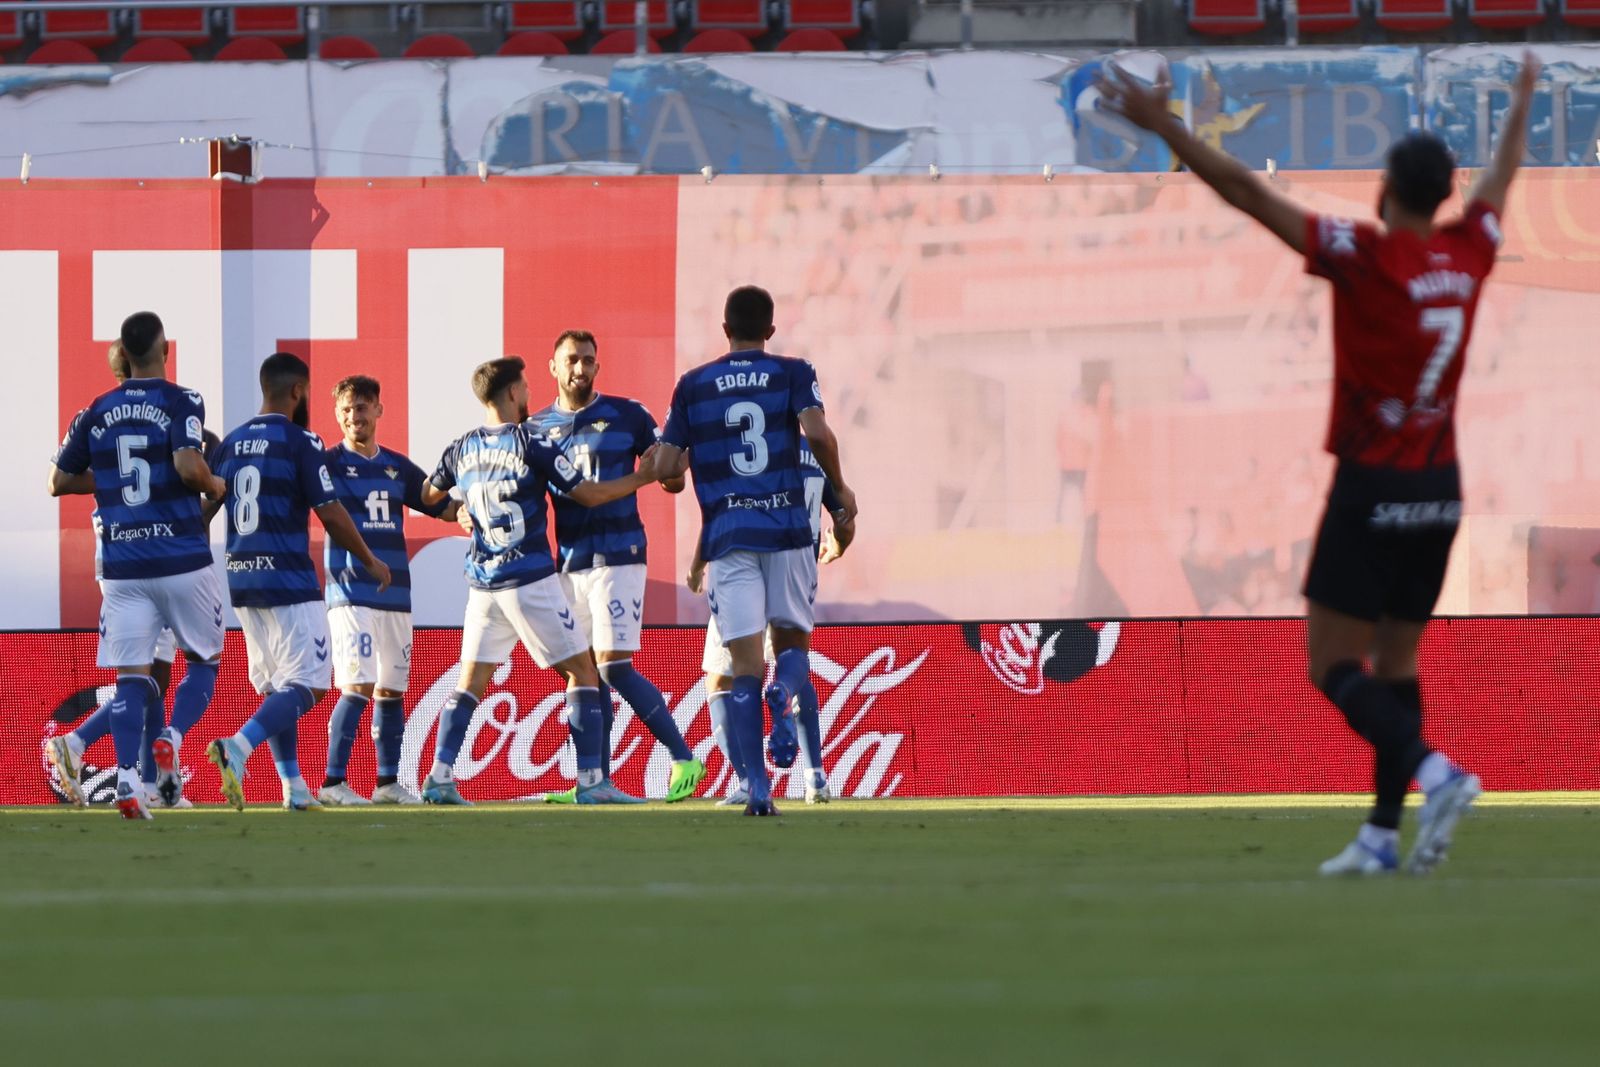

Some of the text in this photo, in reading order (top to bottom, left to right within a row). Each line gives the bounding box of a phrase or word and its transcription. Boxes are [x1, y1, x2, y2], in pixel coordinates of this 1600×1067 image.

[715, 371, 770, 392] EDGAR
[1418, 305, 1464, 402] 7
[91, 424, 106, 440] G.
[104, 400, 171, 433] RODRÍGUEZ
[235, 439, 269, 456] FEKIR
[724, 401, 769, 477] 3
[116, 434, 151, 507] 5
[233, 465, 261, 536] 8
[362, 520, 396, 530] network
[465, 479, 526, 547] 15
